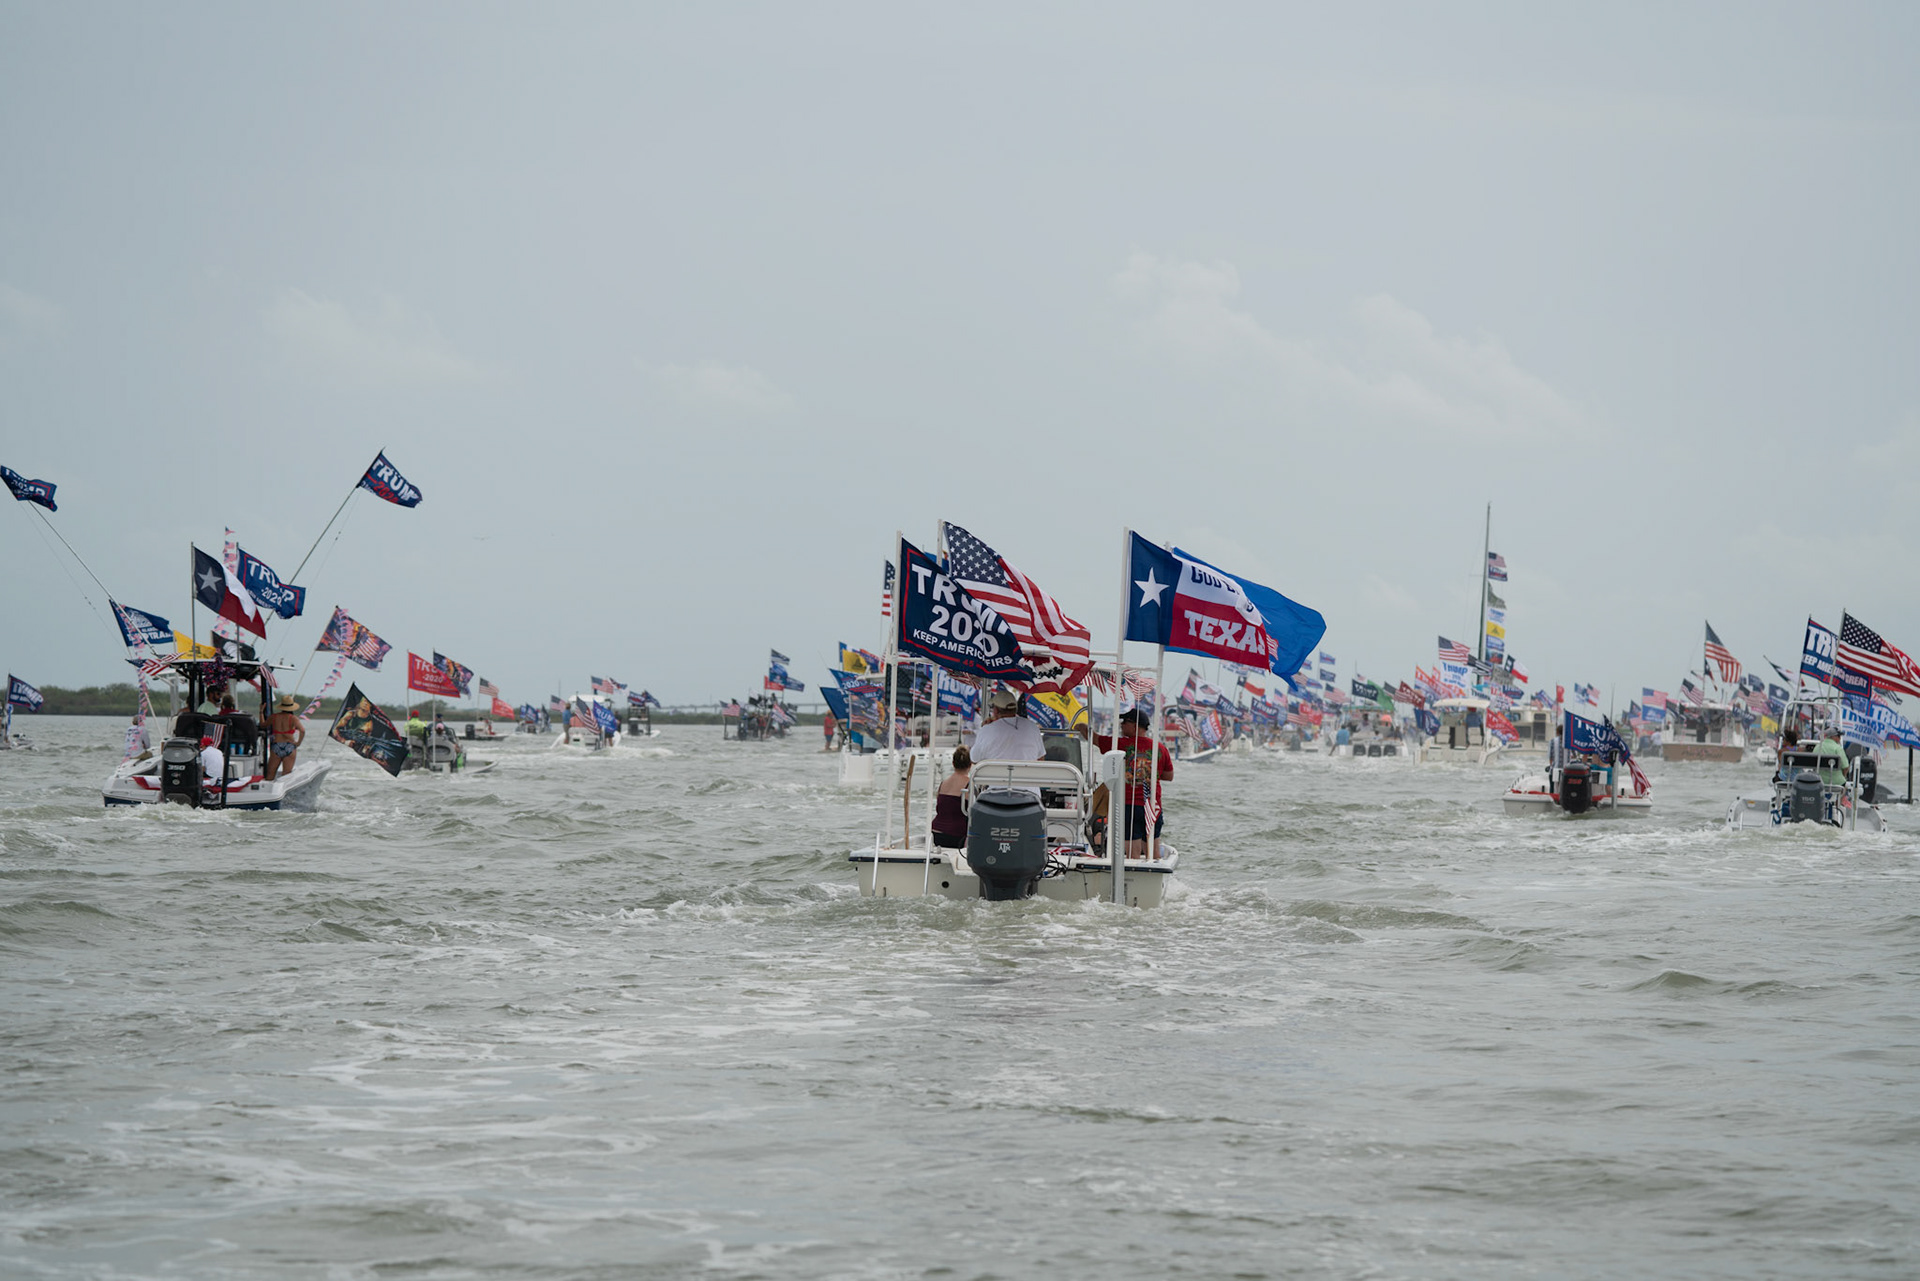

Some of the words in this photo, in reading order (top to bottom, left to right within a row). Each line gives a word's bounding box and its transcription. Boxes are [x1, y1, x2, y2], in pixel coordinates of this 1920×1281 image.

[247, 560, 295, 602] TRUP
[913, 628, 939, 646] KEEP
[939, 639, 986, 662] AMERIC
[985, 654, 1013, 668] FIRS
[1805, 625, 1839, 661] TRU
[962, 658, 975, 668] 45
[1219, 699, 1243, 718] TRUMP
[1253, 699, 1278, 715] TRUMP
[1854, 723, 1873, 735] 2020
[990, 827, 1020, 837] 225
